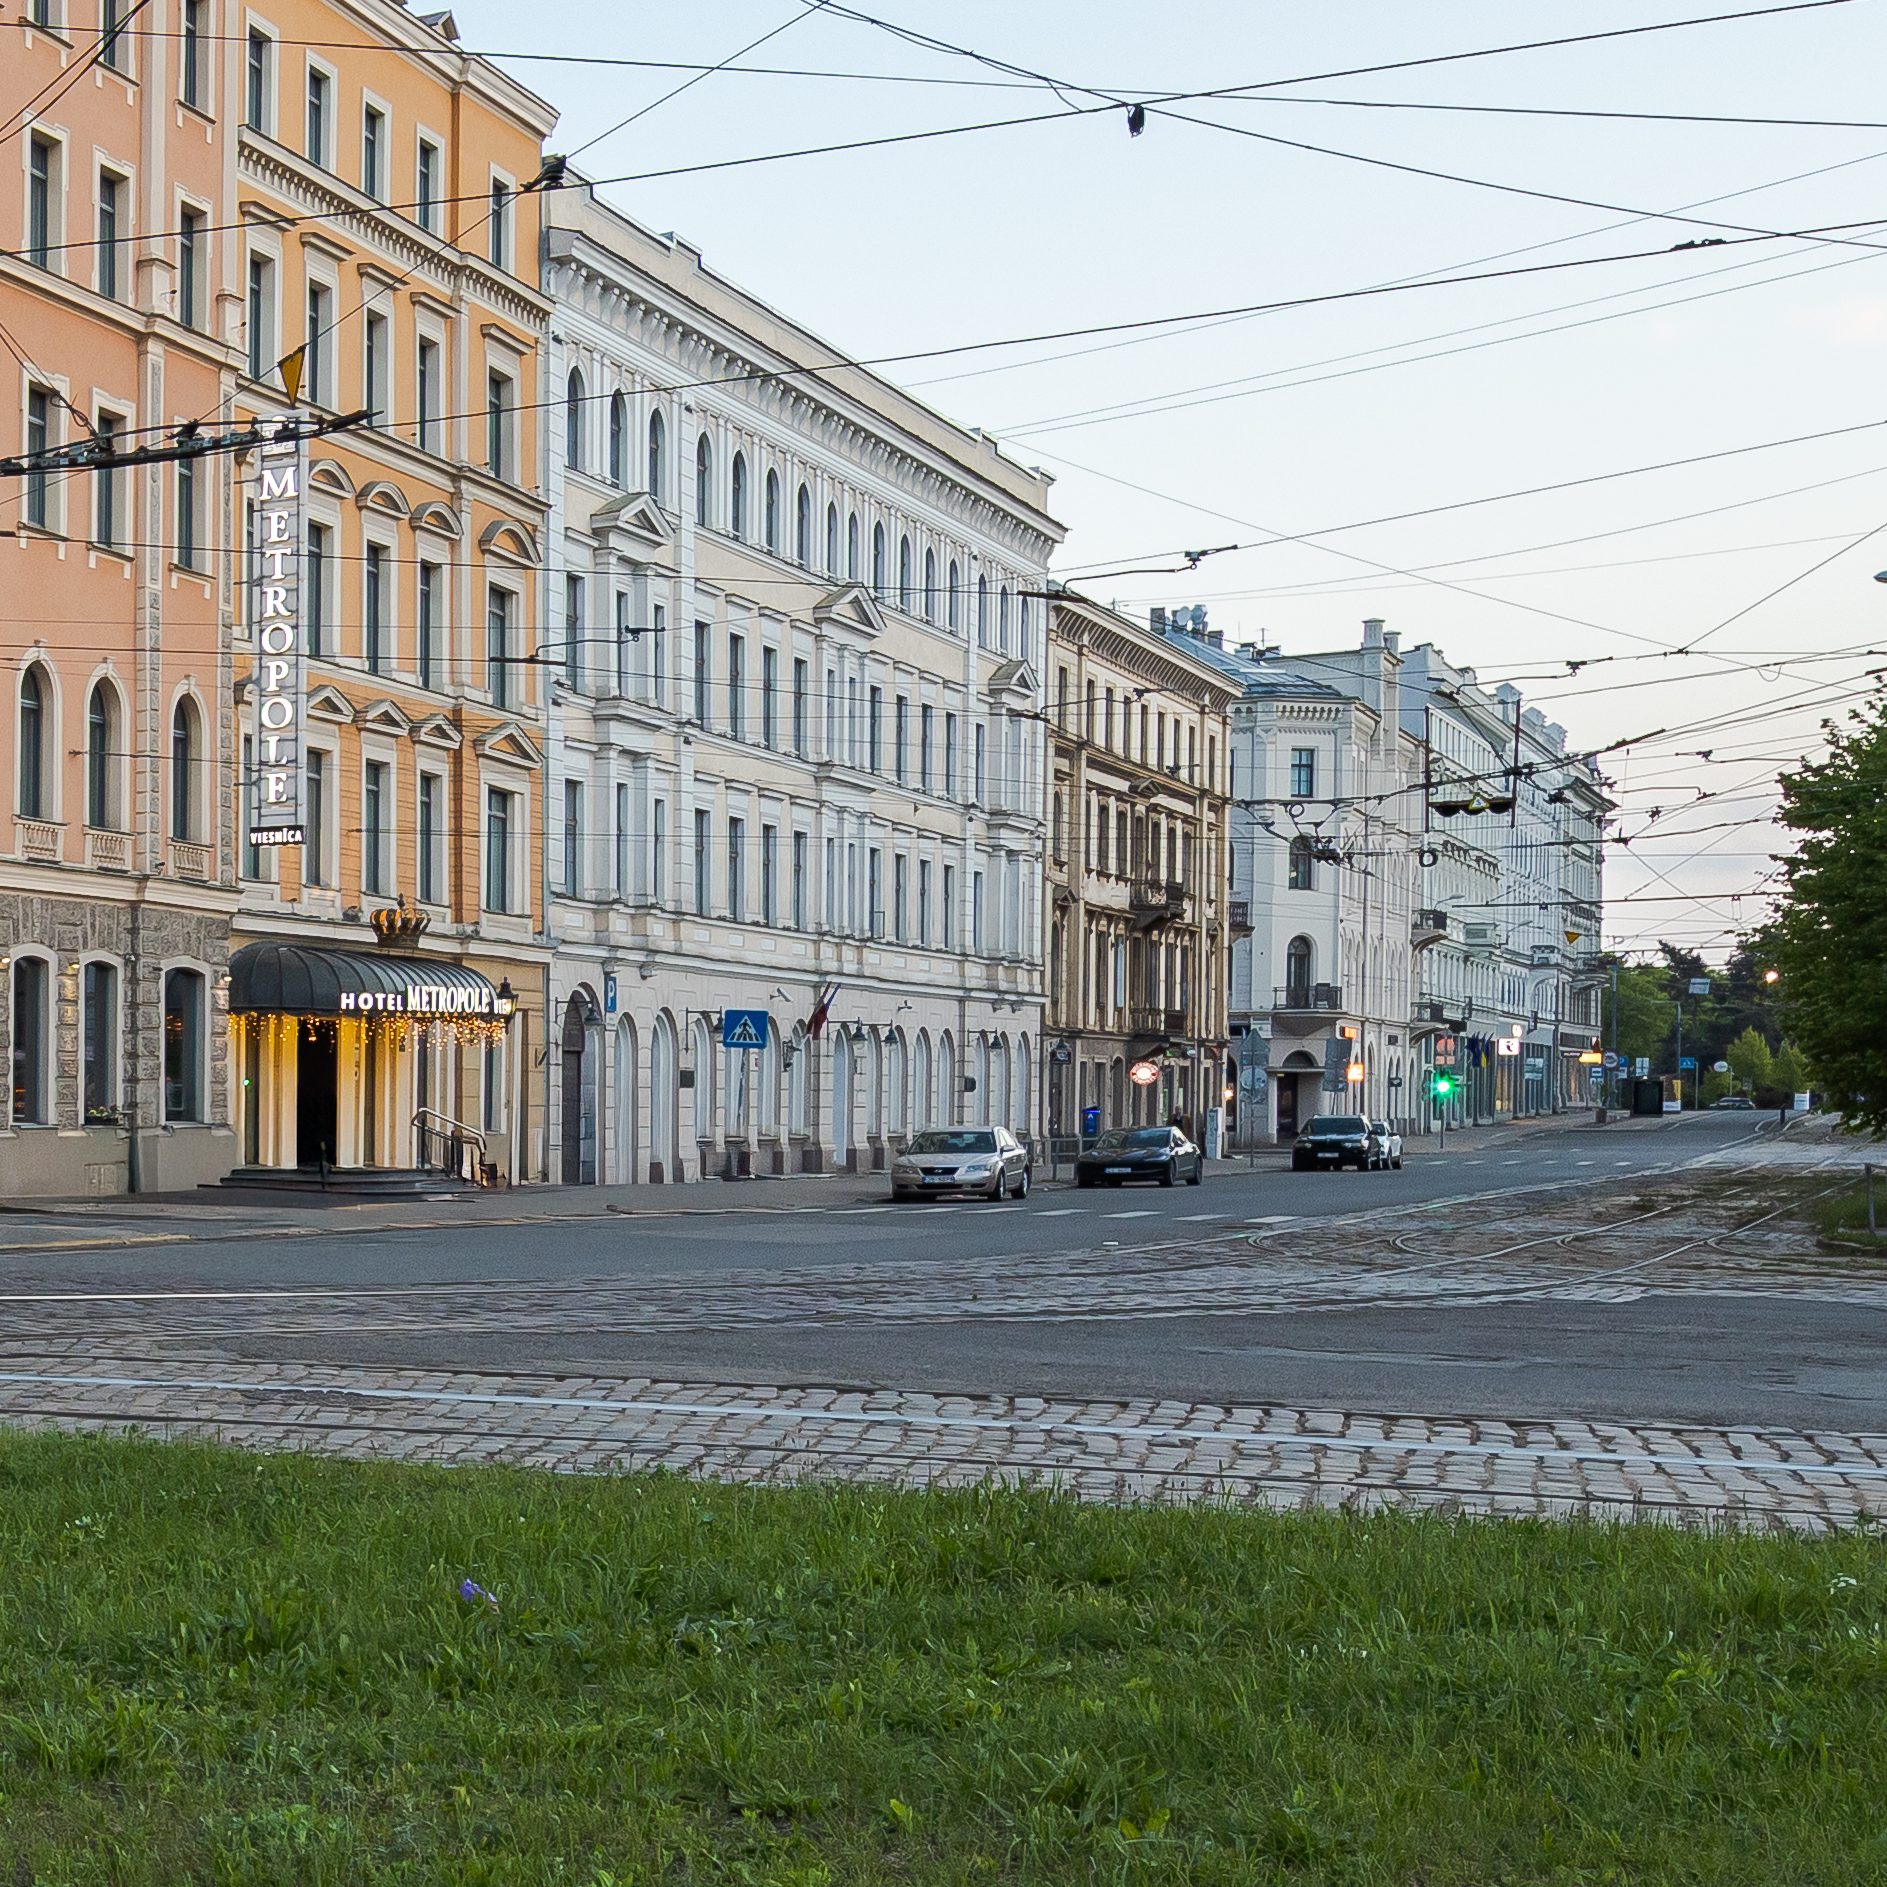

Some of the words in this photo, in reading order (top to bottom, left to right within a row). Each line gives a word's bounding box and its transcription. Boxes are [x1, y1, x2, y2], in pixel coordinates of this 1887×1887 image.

[259, 466, 299, 804] METROPOLE
[250, 827, 303, 844] VIESNĪCA
[340, 992, 404, 1011] HOTEL
[406, 984, 490, 1013] METROPOLE
